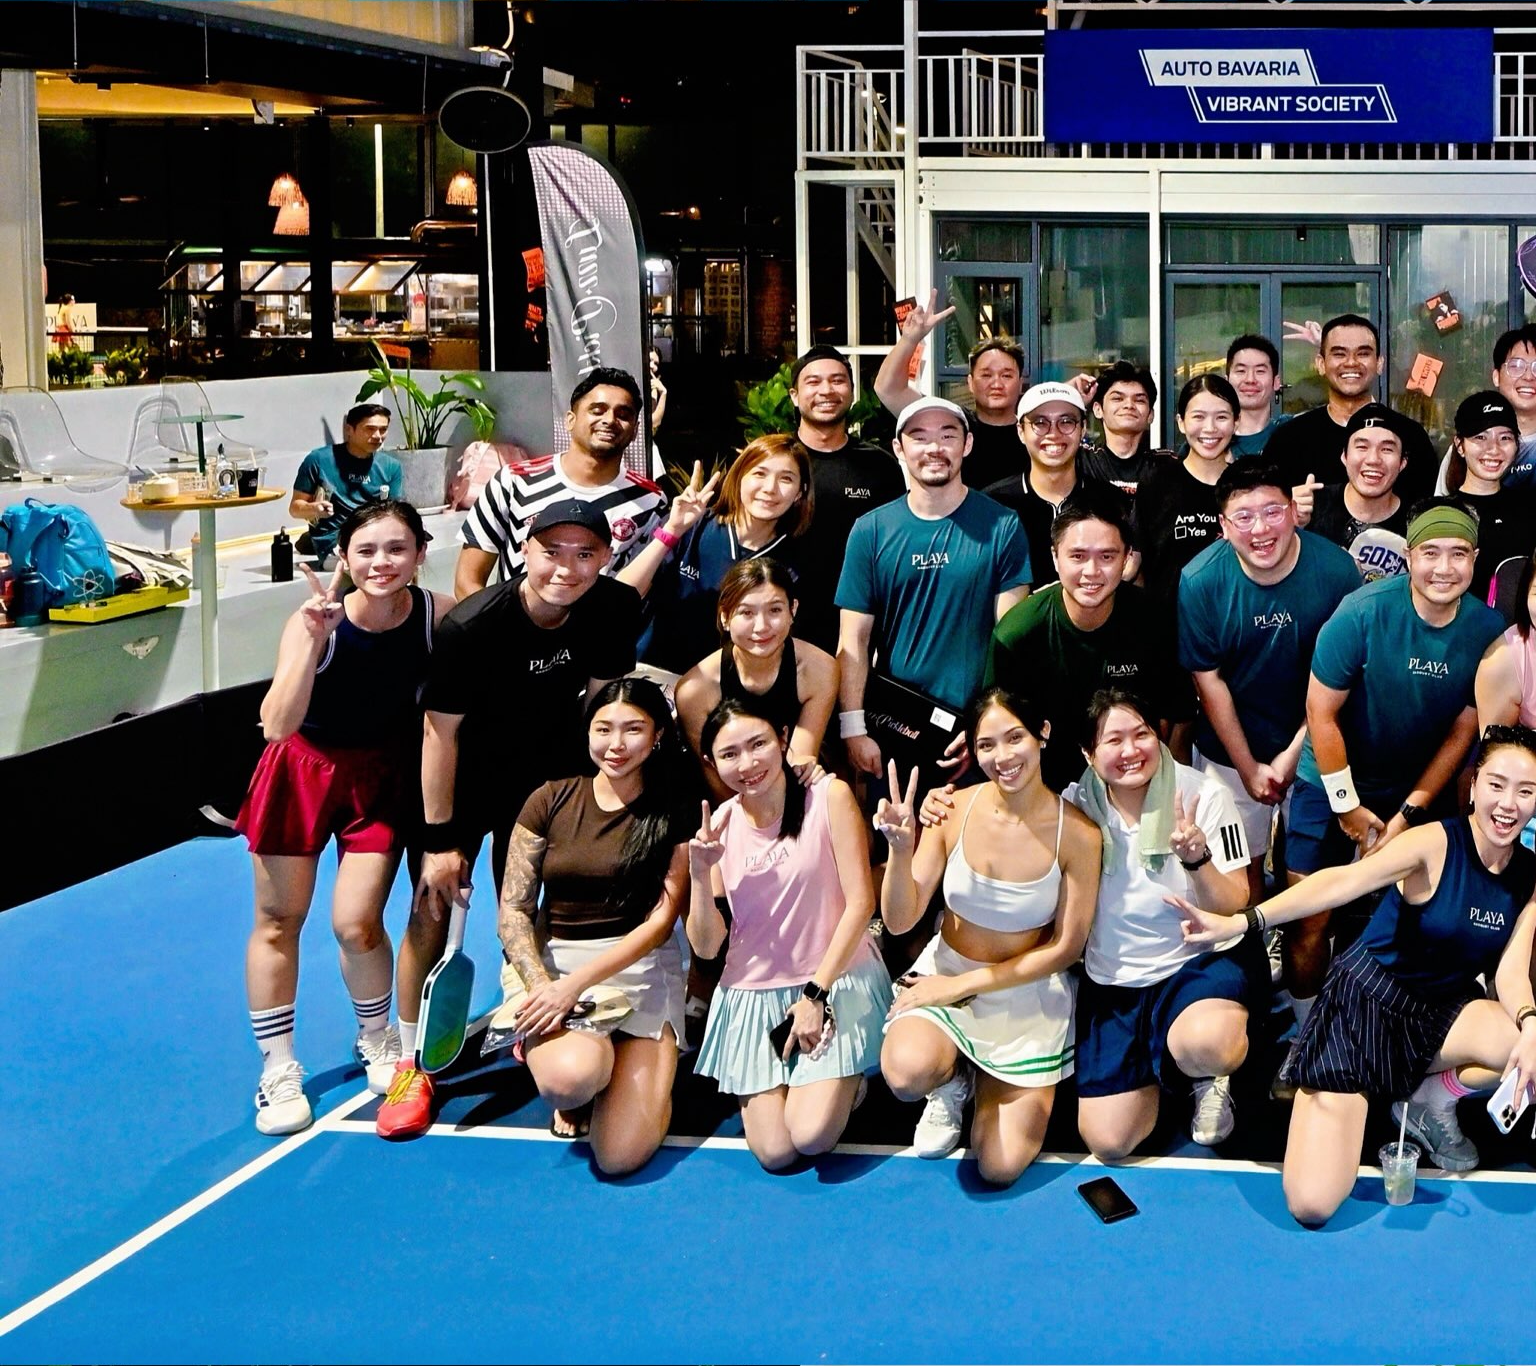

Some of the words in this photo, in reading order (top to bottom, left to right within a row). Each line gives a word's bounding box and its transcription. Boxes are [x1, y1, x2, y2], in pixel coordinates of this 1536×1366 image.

[1160, 60, 1213, 77] AUTO
[1216, 60, 1301, 77] BAVARIA
[1206, 95, 1291, 112] VIBRANT
[1294, 95, 1376, 112] SOCIETY
[46, 315, 91, 330] PLYA
[845, 487, 871, 497] PLAYA
[1175, 515, 1195, 527] Are
[1196, 513, 1217, 524] You
[1188, 527, 1207, 537] Yes
[911, 552, 950, 566] PLAYA
[1254, 612, 1293, 627] PLAYA
[530, 648, 572, 671] PLAYA
[1408, 657, 1449, 674] PLAYA
[1107, 664, 1139, 674] PLAYA
[745, 846, 791, 870] PLAYA
[1469, 906, 1506, 926] PLAYA
